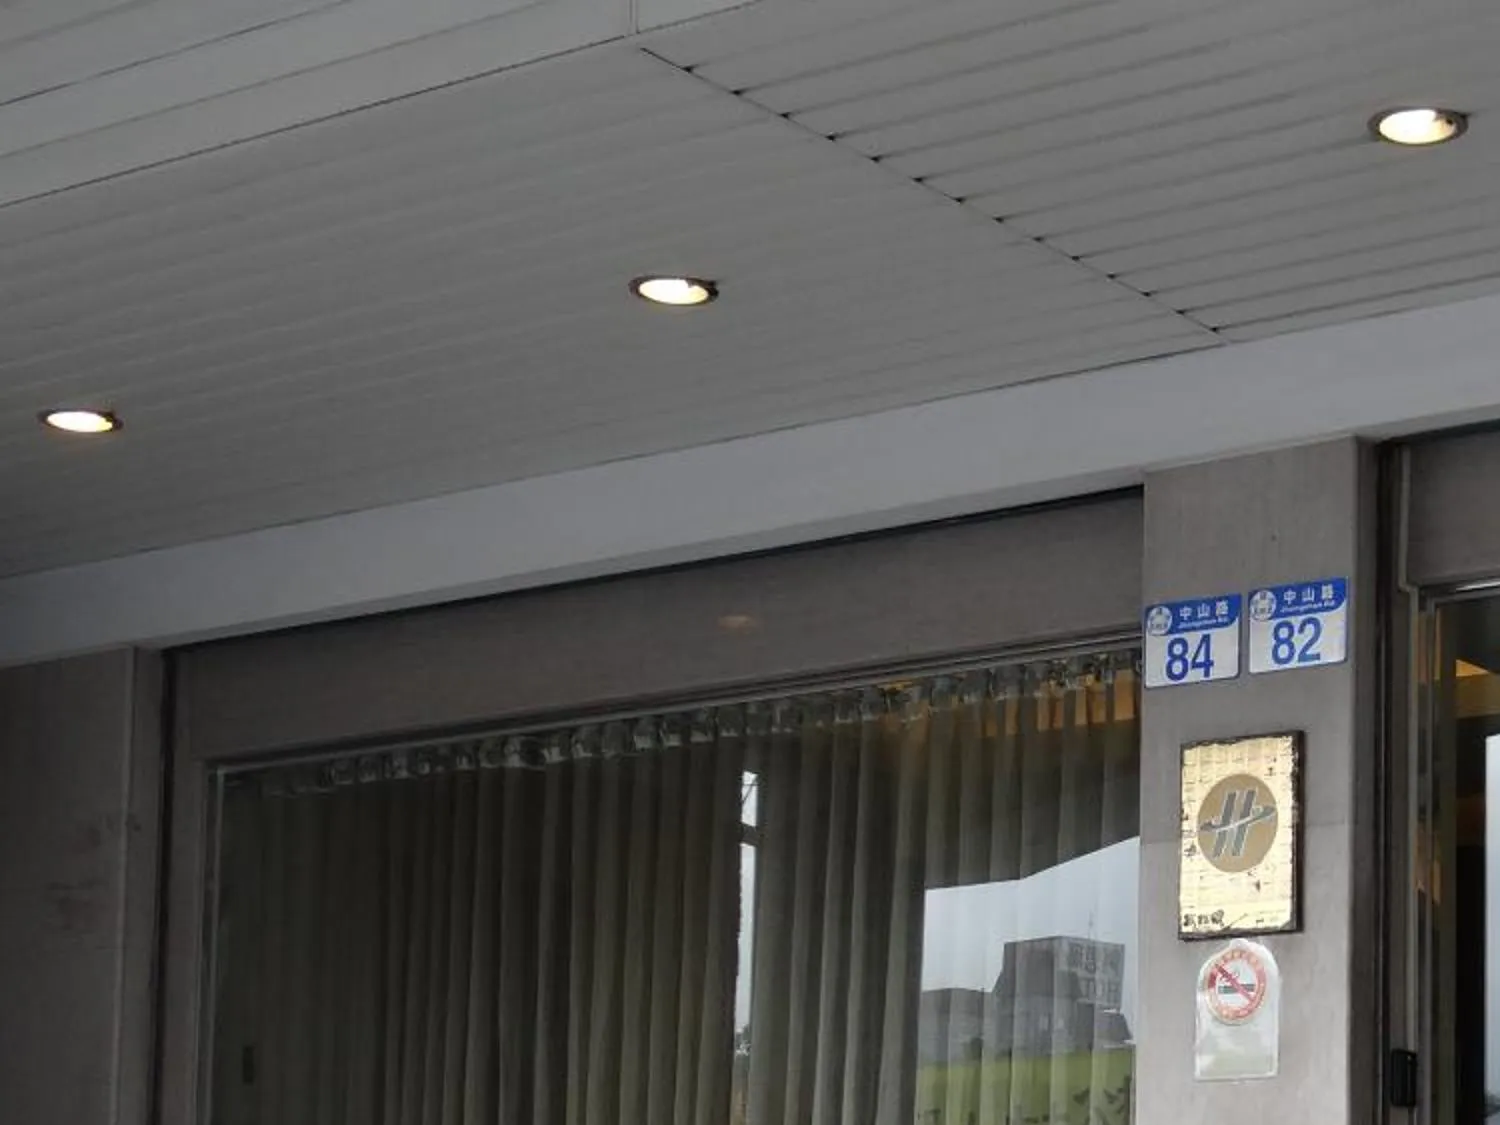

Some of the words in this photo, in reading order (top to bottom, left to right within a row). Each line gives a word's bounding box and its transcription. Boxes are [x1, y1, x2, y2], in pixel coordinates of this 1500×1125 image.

[1179, 600, 1229, 621] 中山路
[1283, 583, 1334, 605] 中山路
[1165, 633, 1214, 681] 84
[1271, 616, 1322, 665] 82
